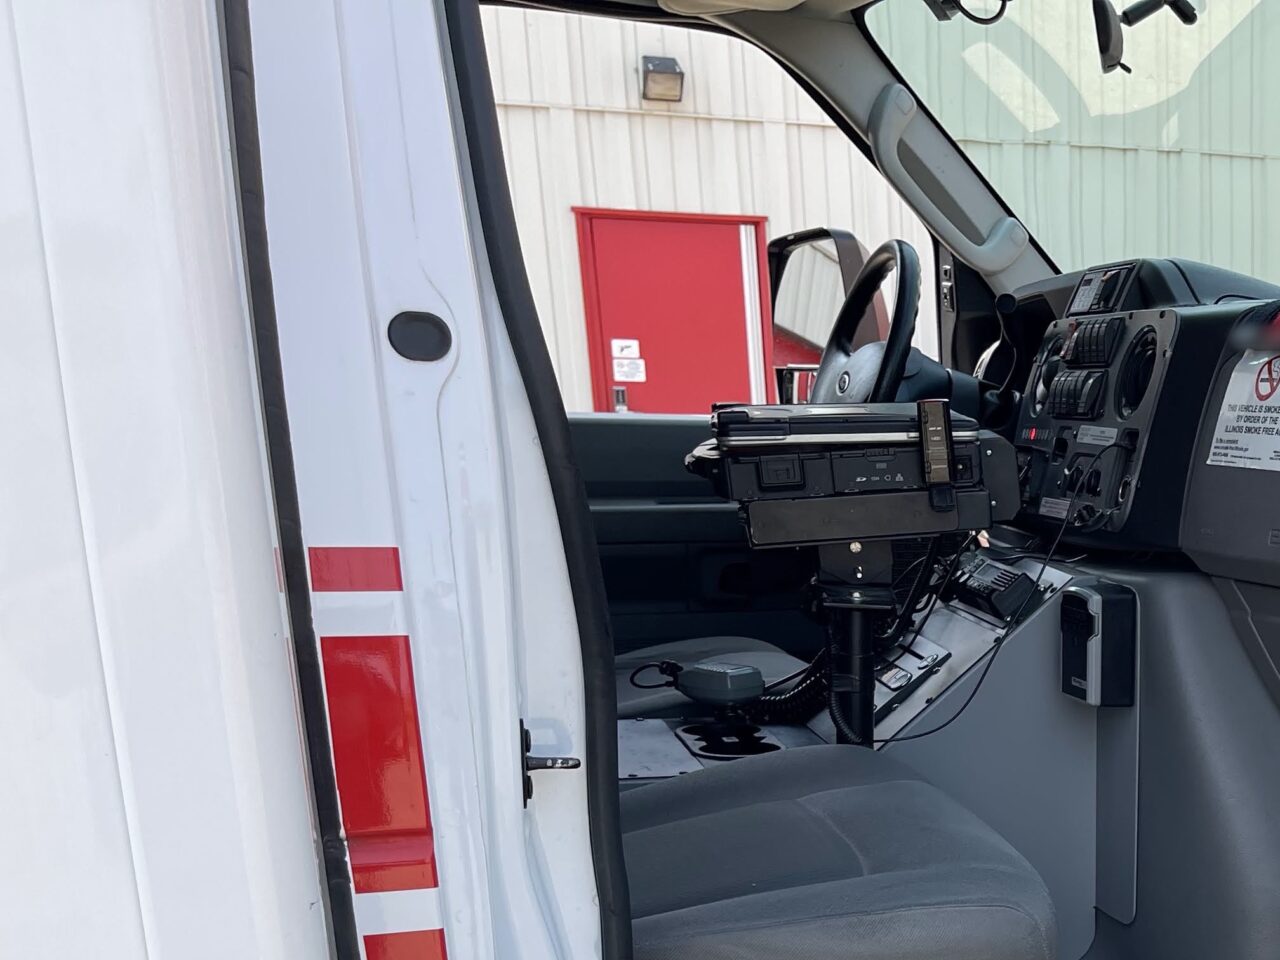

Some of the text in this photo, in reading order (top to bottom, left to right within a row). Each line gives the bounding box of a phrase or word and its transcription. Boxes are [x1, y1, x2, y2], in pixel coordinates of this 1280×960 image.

[1238, 405, 1258, 413] VEHICLE
[1236, 415, 1279, 425] BY ORDER OF THE
[1225, 425, 1244, 434] ILLINOIS
[1244, 426, 1262, 435] SMOKE
[1261, 428, 1275, 436] FREE
